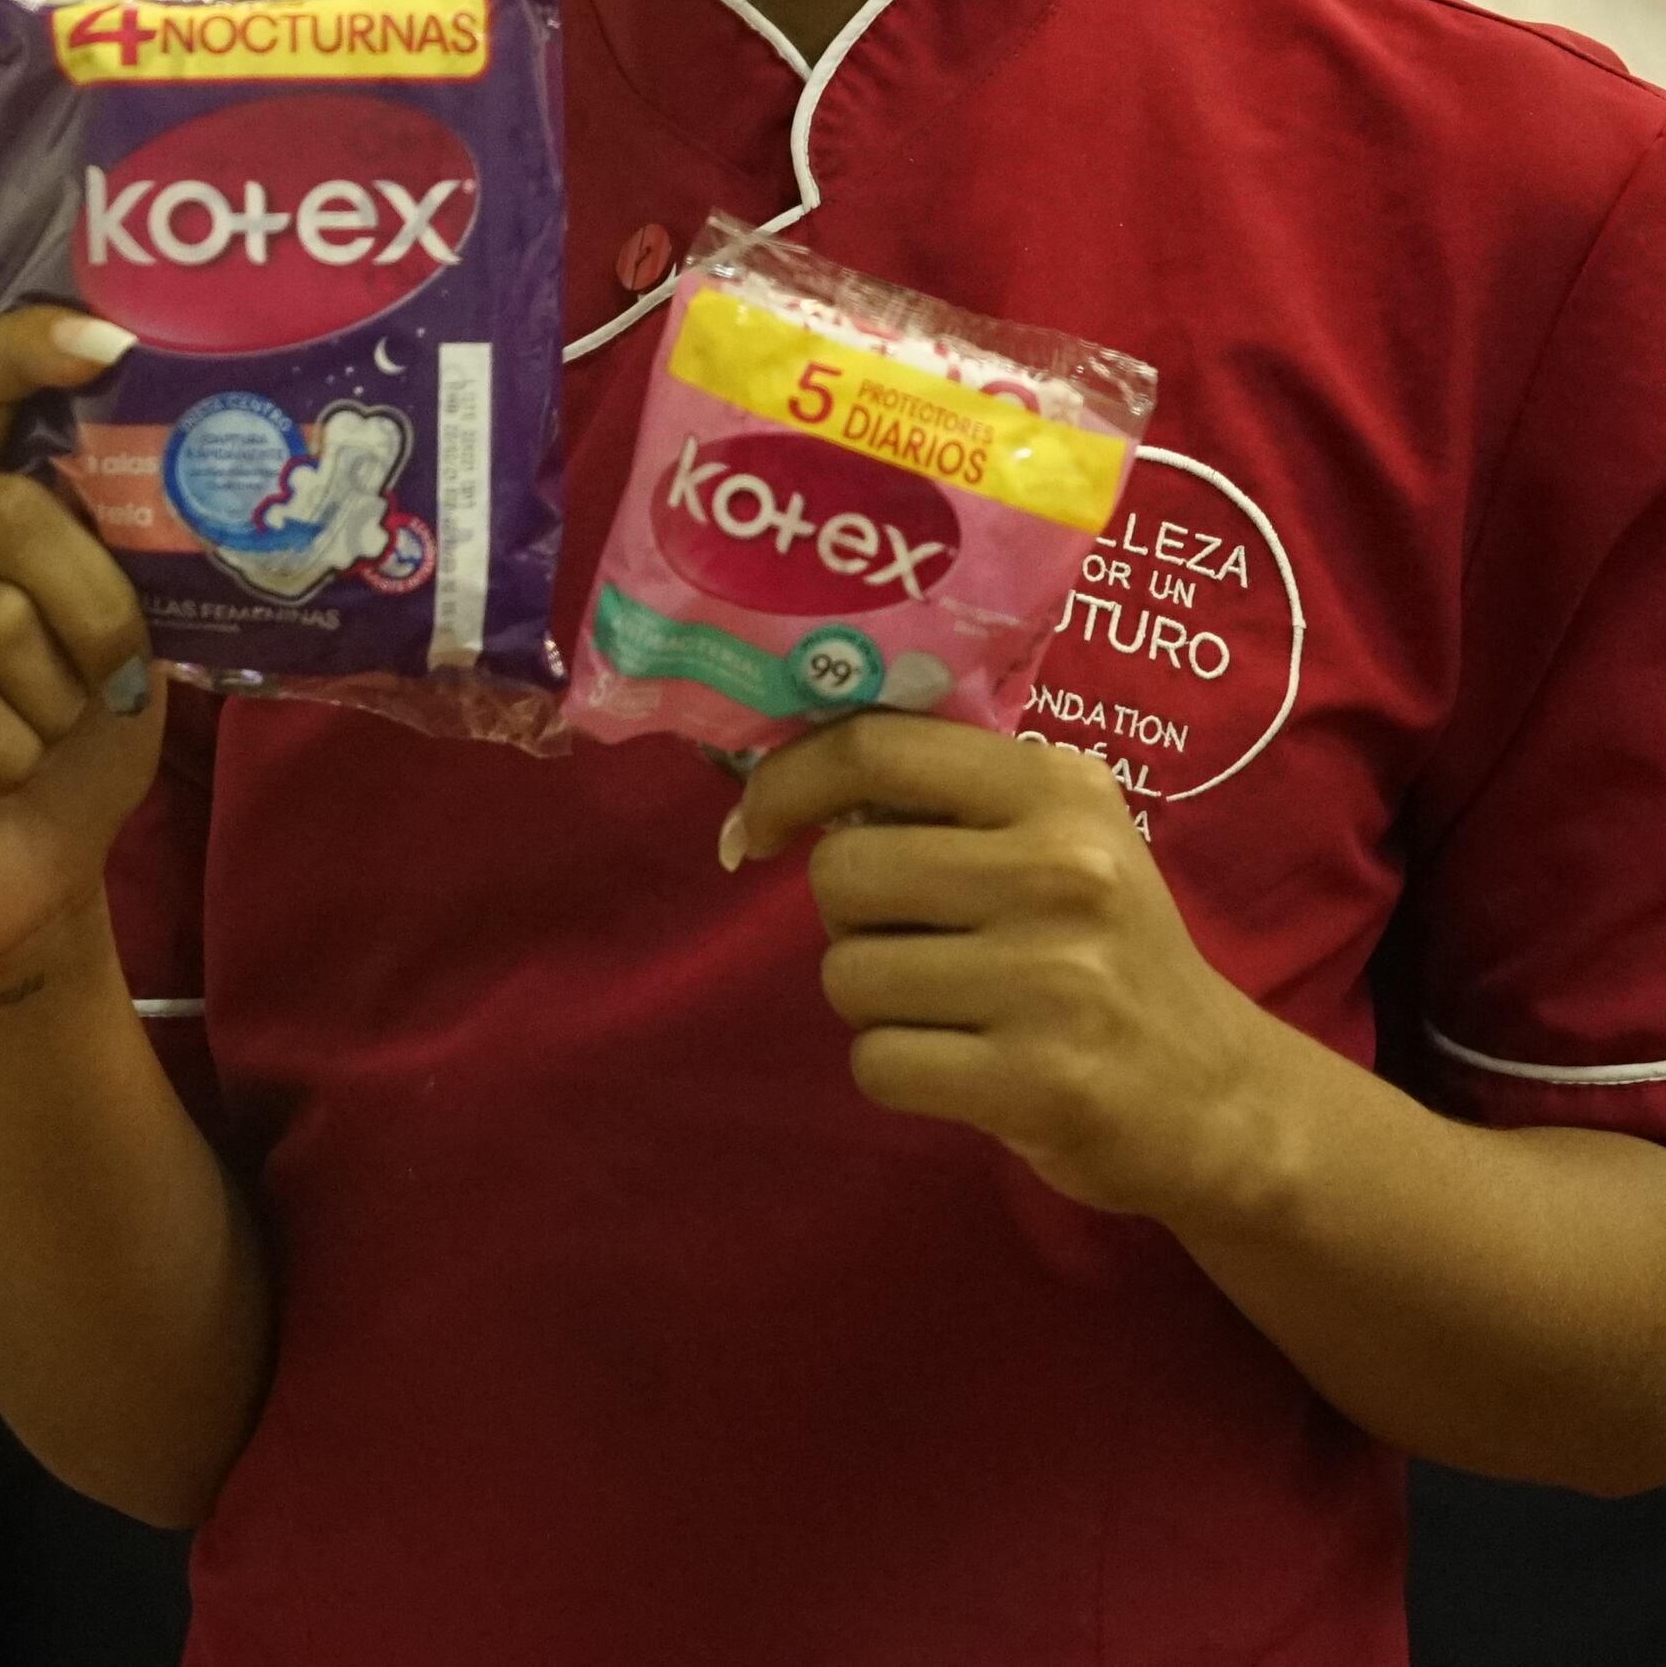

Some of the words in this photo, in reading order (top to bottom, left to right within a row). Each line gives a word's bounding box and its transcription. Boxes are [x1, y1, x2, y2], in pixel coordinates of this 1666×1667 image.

[69, 1, 157, 66] 4
[160, 11, 480, 55] NOCTURNAS
[85, 164, 462, 266] kotex
[787, 361, 843, 425] 5
[857, 377, 994, 447] PROTECTORES
[842, 404, 991, 485] DIARIOS
[667, 435, 945, 602] kotex
[1095, 512, 1249, 588] LEZA
[1083, 554, 1131, 589] OR
[1149, 570, 1197, 609] UN
